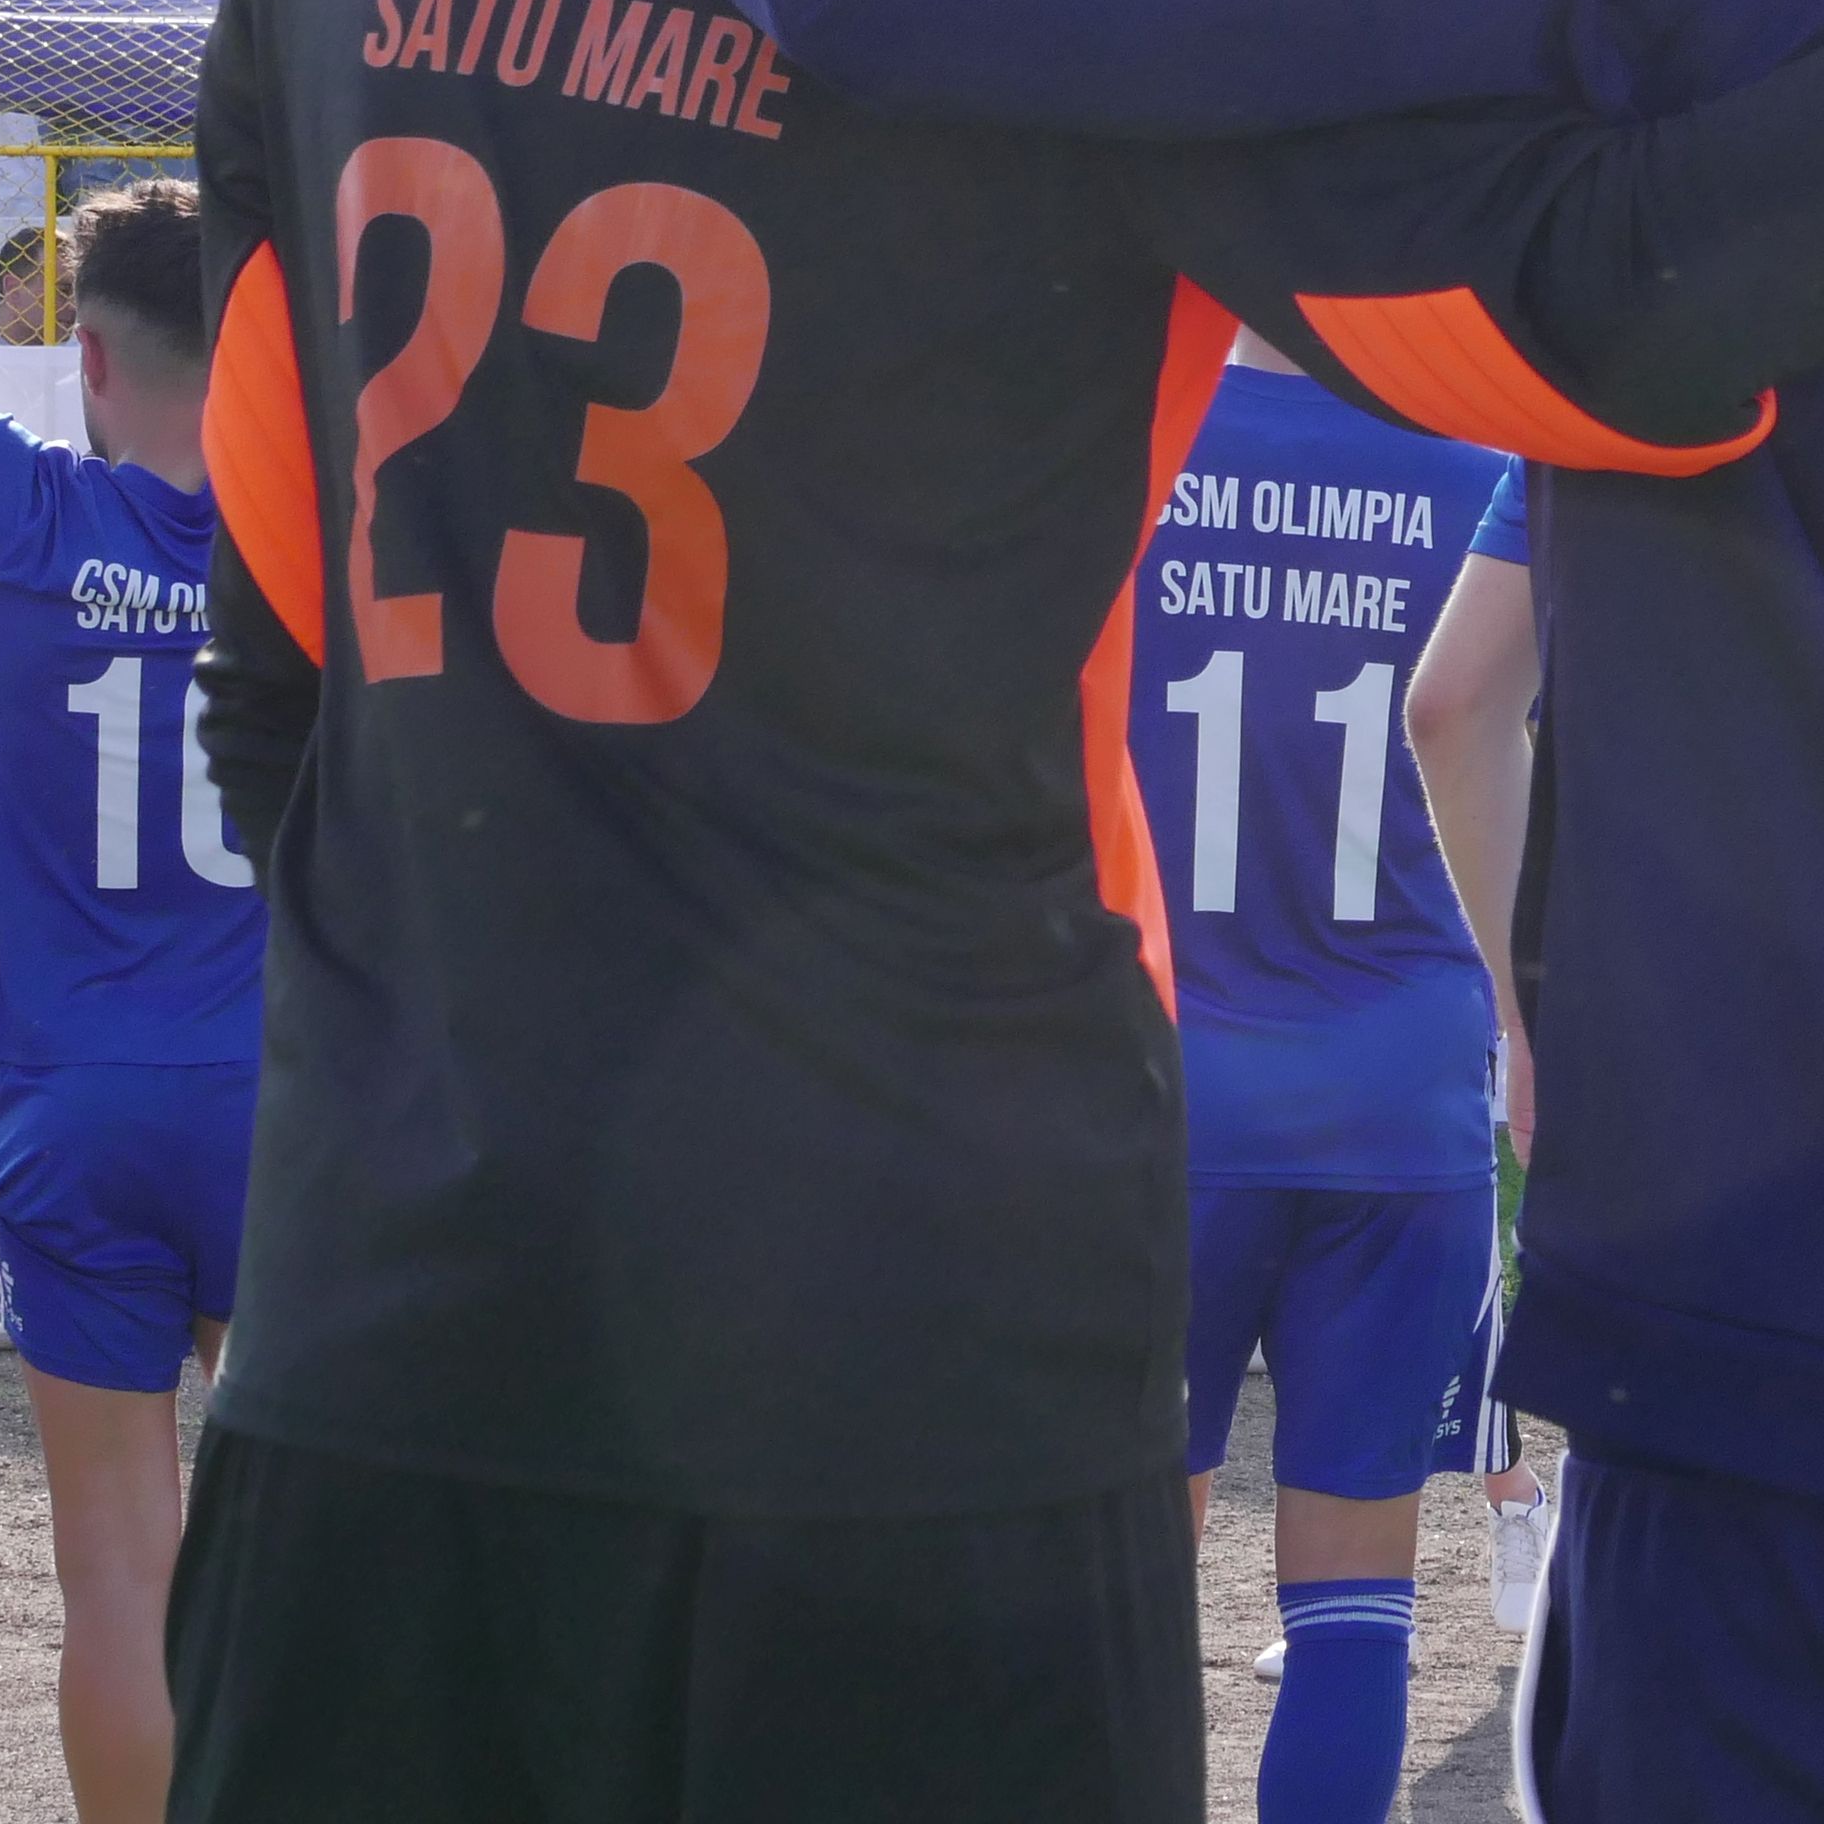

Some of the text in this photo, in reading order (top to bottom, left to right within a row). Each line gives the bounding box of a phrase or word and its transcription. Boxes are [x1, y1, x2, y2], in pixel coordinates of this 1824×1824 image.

[560, 1, 792, 142] MARE
[335, 135, 773, 726] 23
[1252, 479, 1435, 550] OLIMPIA
[71, 558, 160, 611] CSM
[1159, 559, 1412, 633] SATU MARE
[1165, 649, 1395, 922] 11
